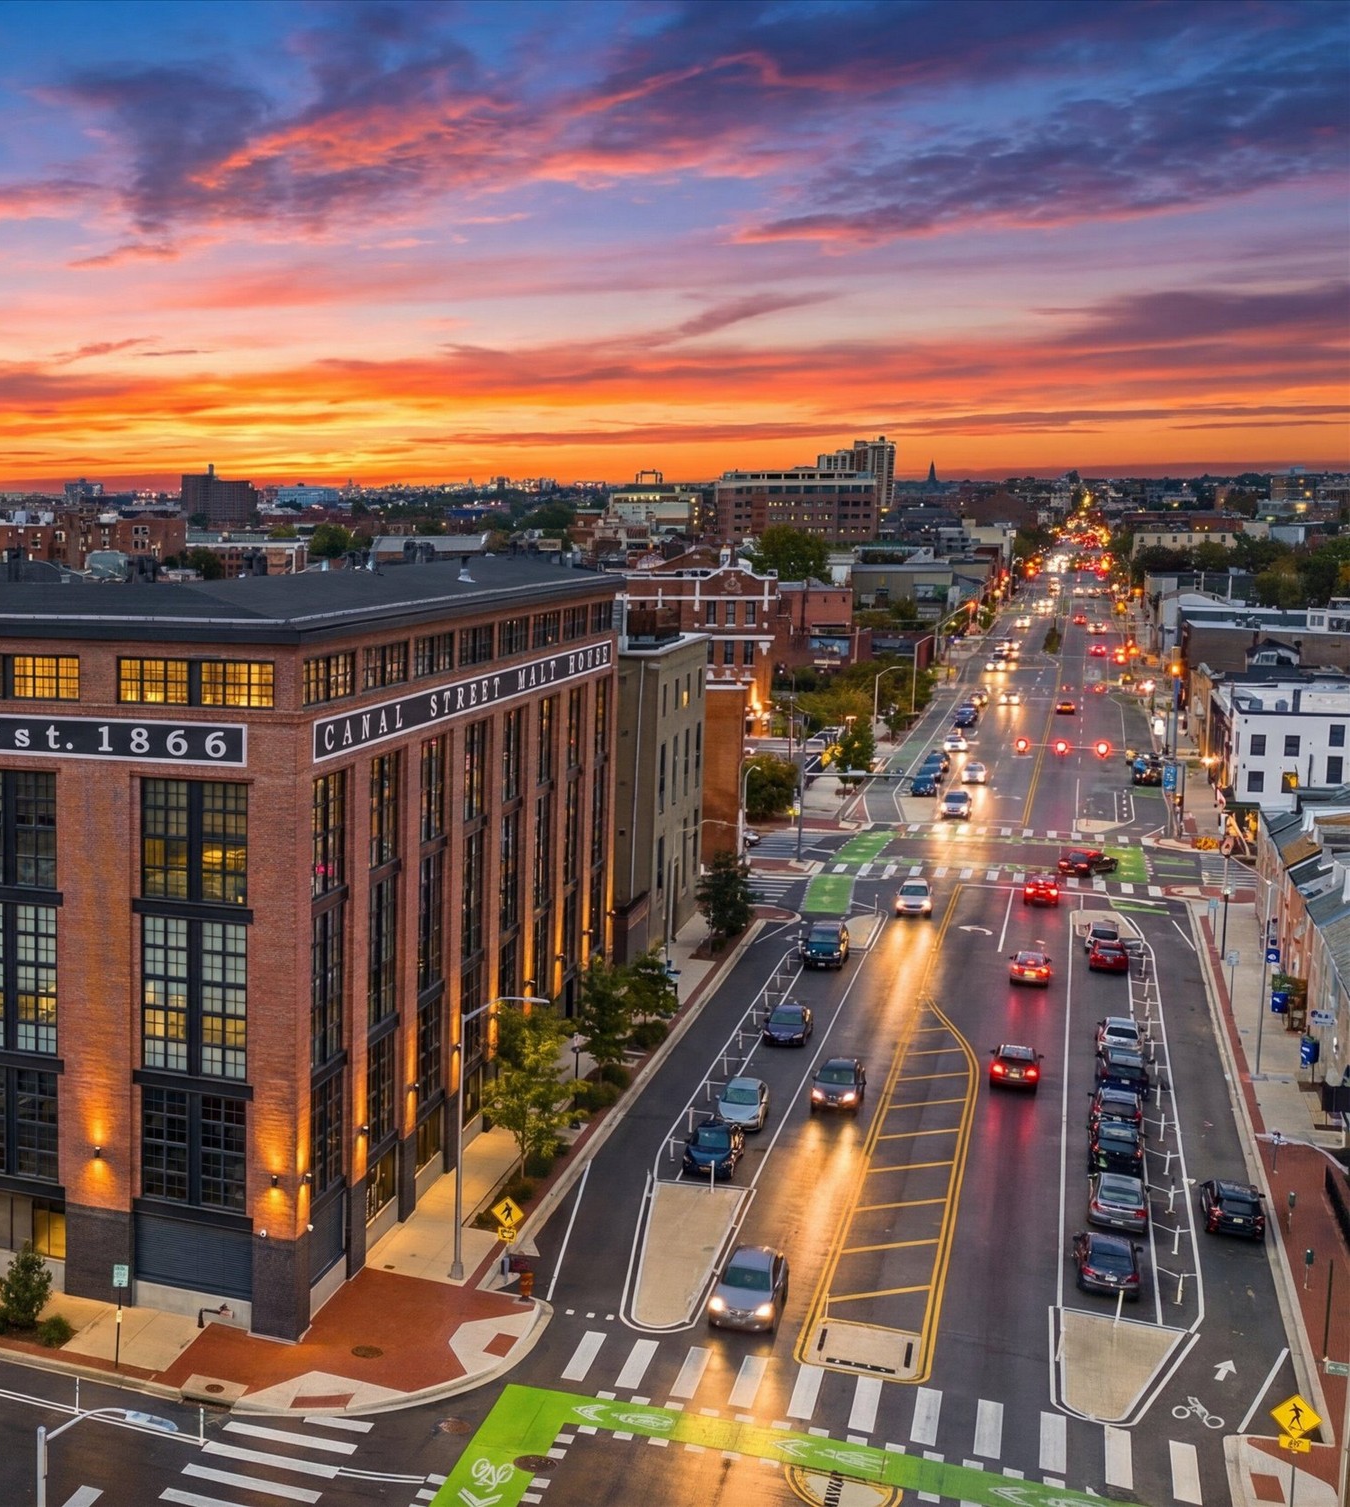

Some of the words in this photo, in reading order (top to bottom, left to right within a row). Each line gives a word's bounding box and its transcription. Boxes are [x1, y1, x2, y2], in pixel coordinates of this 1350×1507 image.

[324, 704, 403, 751] CANAL
[430, 677, 500, 717] STREET
[517, 662, 557, 691] MALT
[568, 646, 608, 674] HOUSE
[98, 725, 227, 758] 1866
